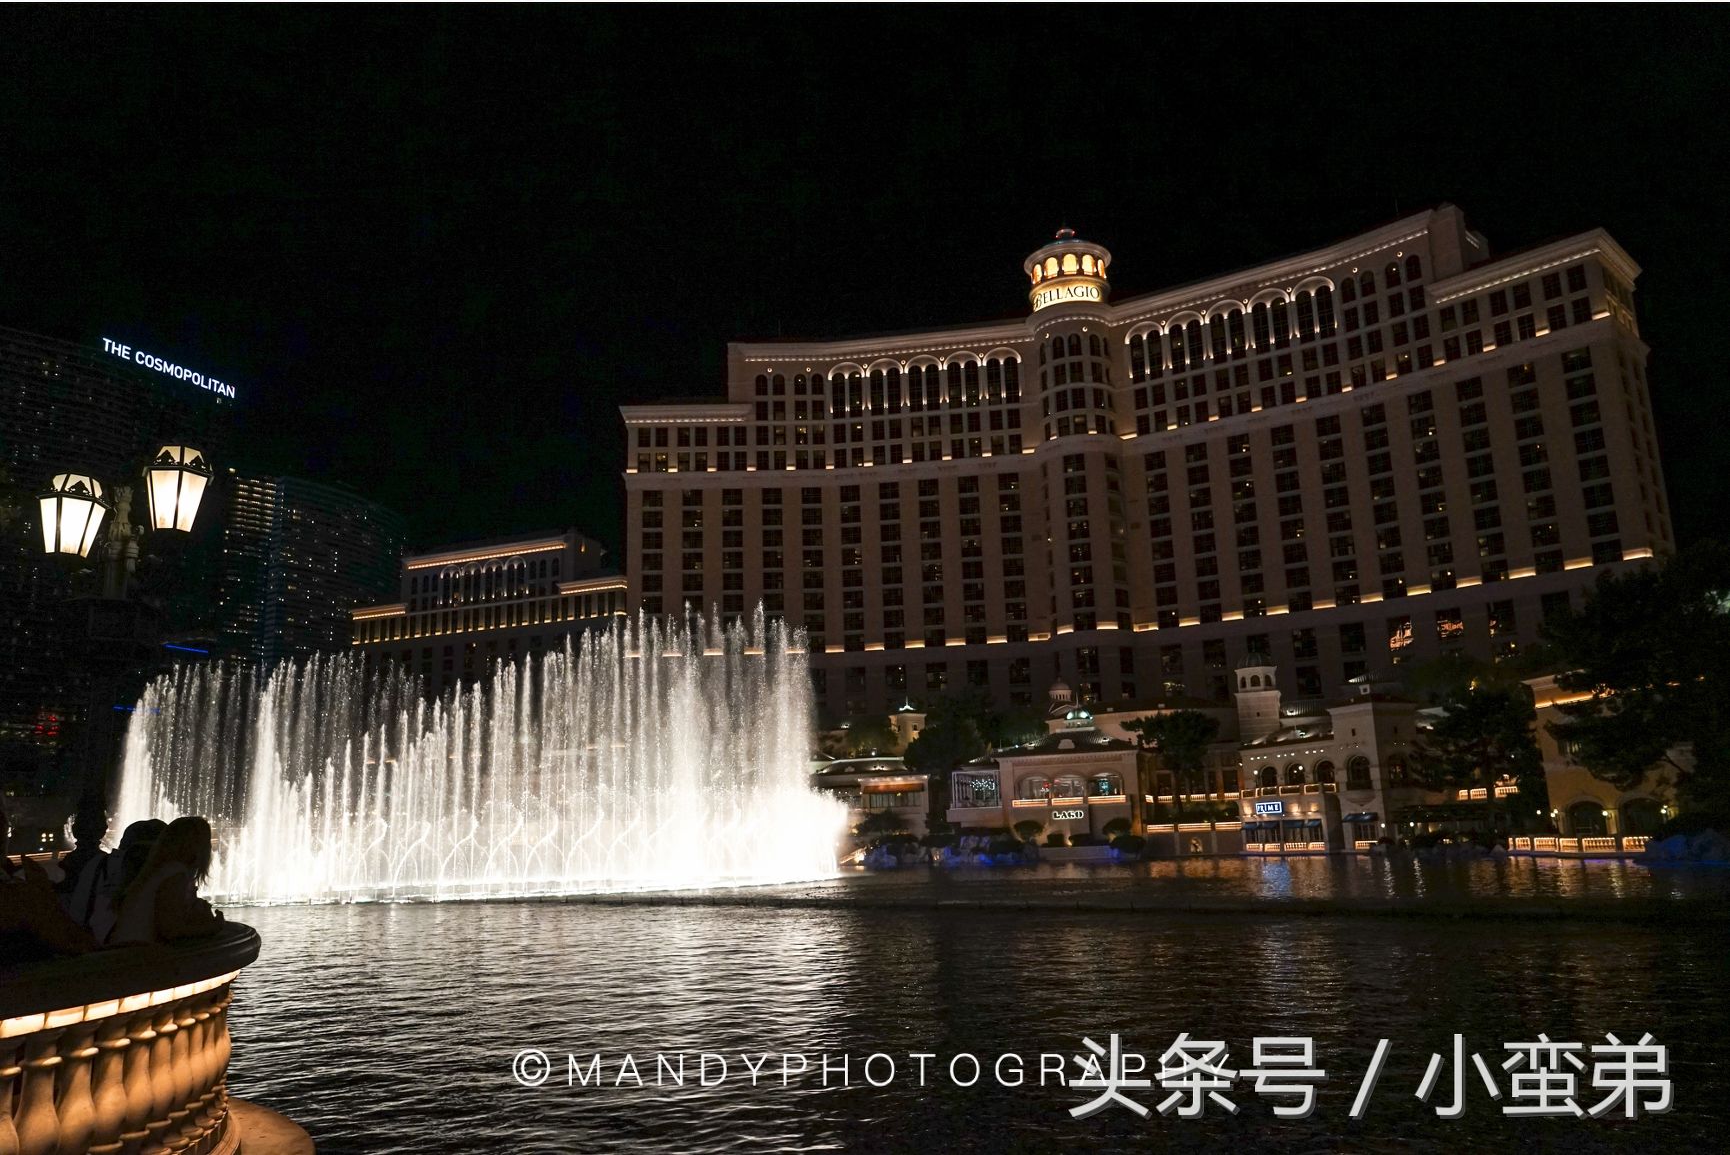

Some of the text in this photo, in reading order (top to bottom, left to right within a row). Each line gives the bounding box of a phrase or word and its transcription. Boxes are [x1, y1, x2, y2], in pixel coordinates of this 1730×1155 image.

[1033, 285, 1100, 310] BELLAGIO
[102, 337, 236, 399] THE COSMOPOLITAN
